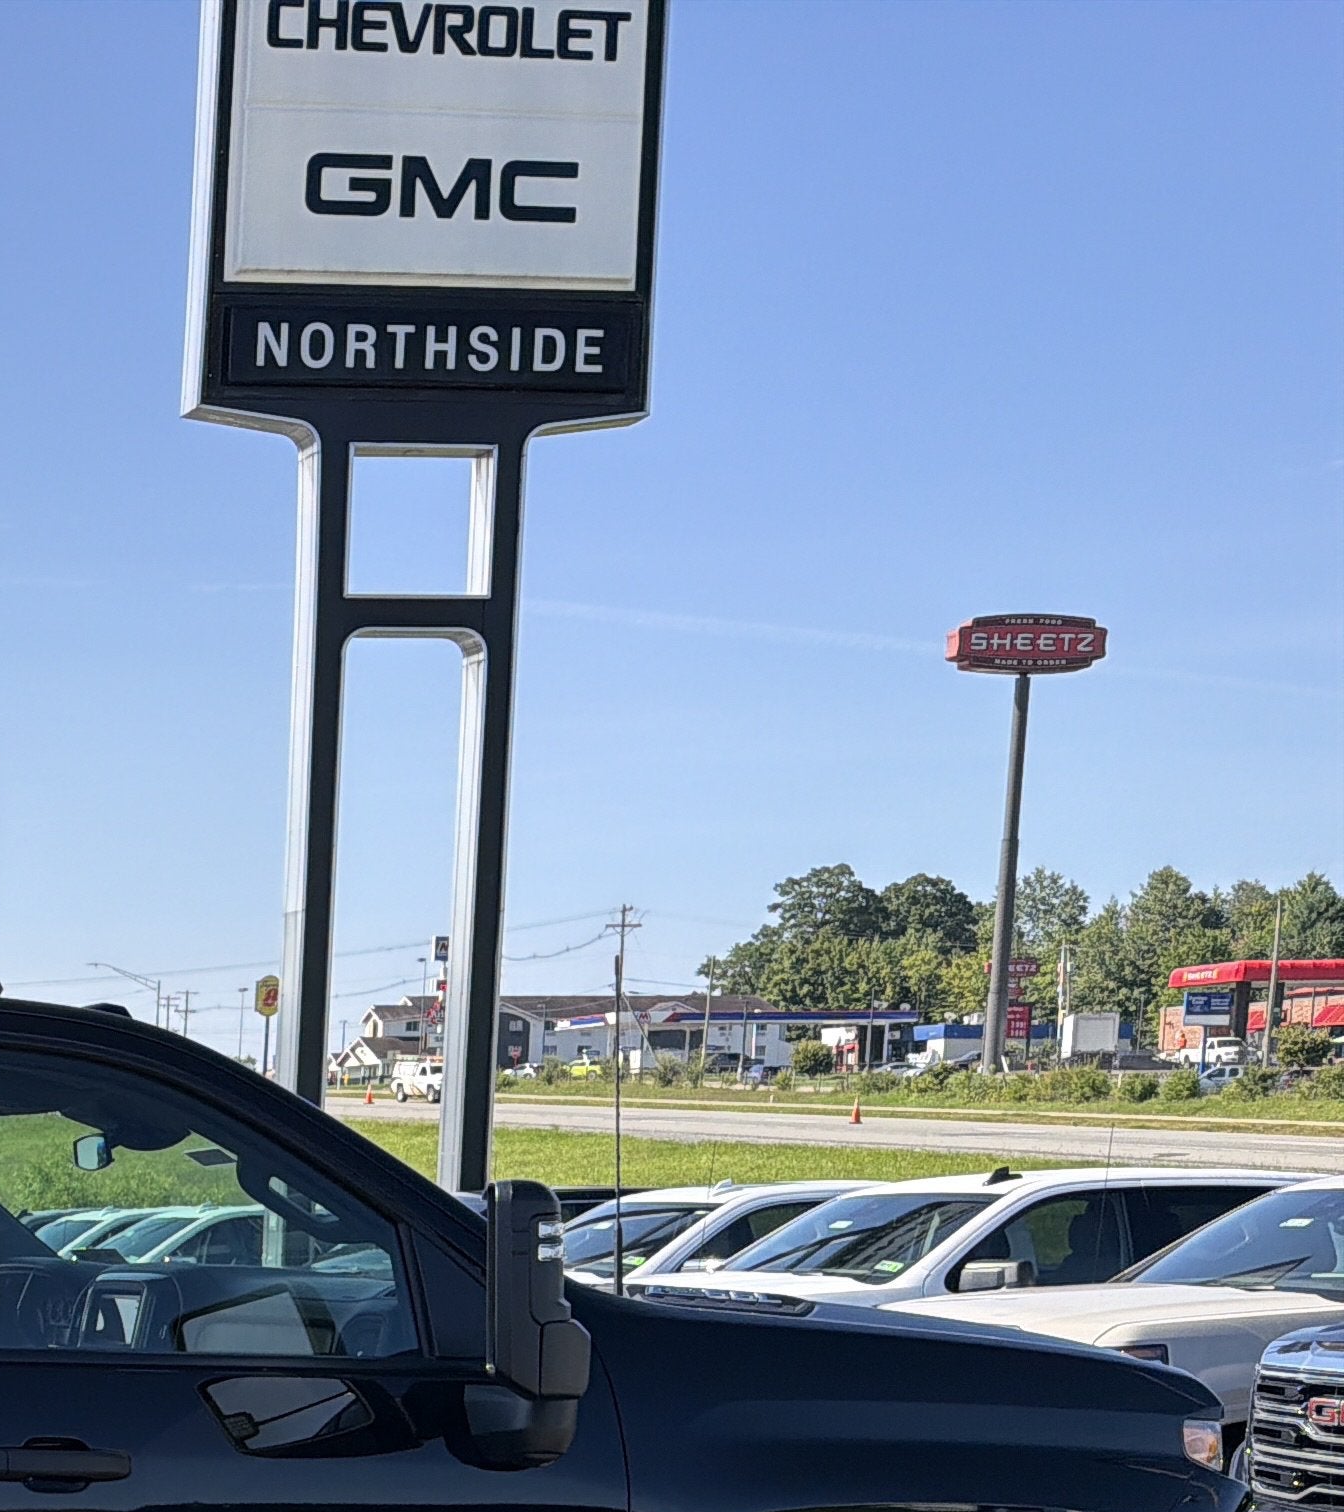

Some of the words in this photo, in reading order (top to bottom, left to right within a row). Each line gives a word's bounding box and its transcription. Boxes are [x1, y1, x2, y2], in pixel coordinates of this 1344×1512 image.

[267, 0, 632, 62] CHEVROLET
[304, 152, 580, 224] GMC
[255, 321, 605, 373] NORTHSIDE
[970, 632, 1095, 652] SHEETZ
